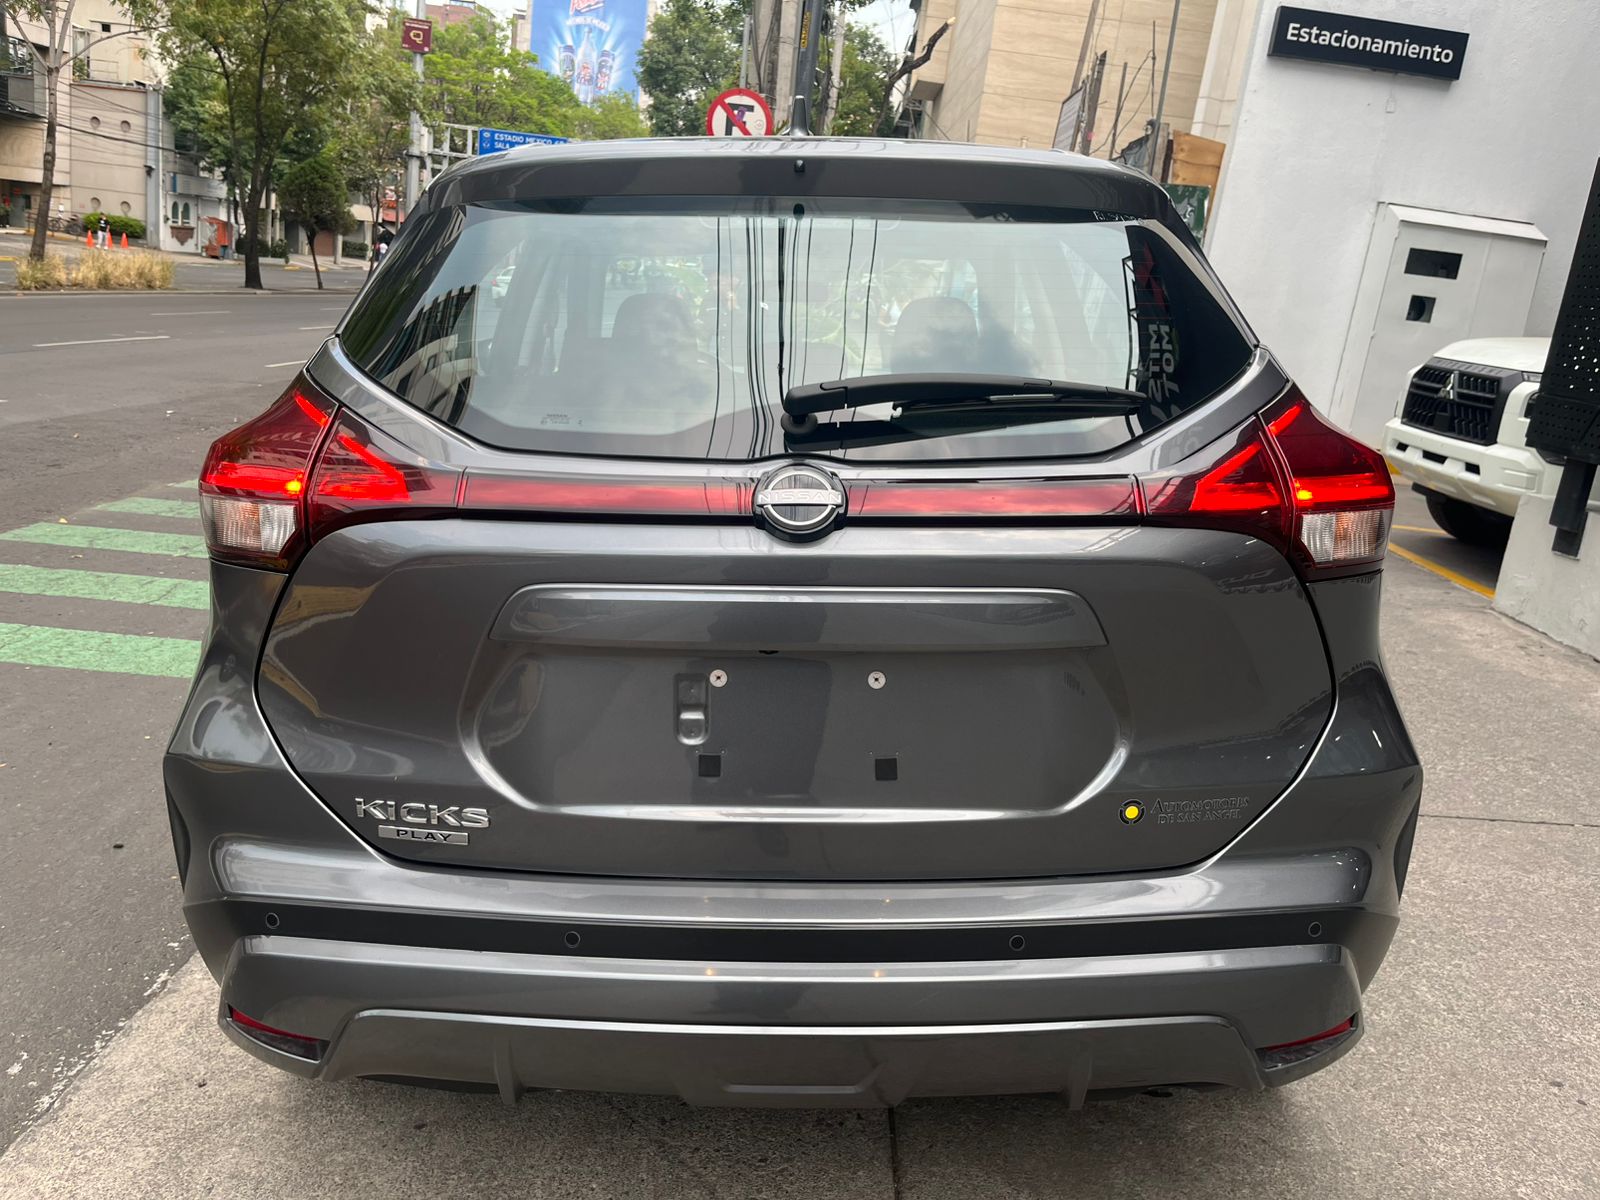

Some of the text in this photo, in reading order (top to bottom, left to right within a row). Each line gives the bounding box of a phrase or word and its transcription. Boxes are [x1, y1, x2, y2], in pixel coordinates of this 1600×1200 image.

[1286, 22, 1454, 63] Estacionamiento
[494, 133, 524, 143] ESTADIO
[494, 141, 510, 149] SALA
[758, 490, 841, 504] NISSAN
[355, 798, 490, 828] KICKS
[1158, 813, 1175, 824] DE
[1177, 811, 1202, 823] SAN
[396, 829, 452, 842] PLAY
